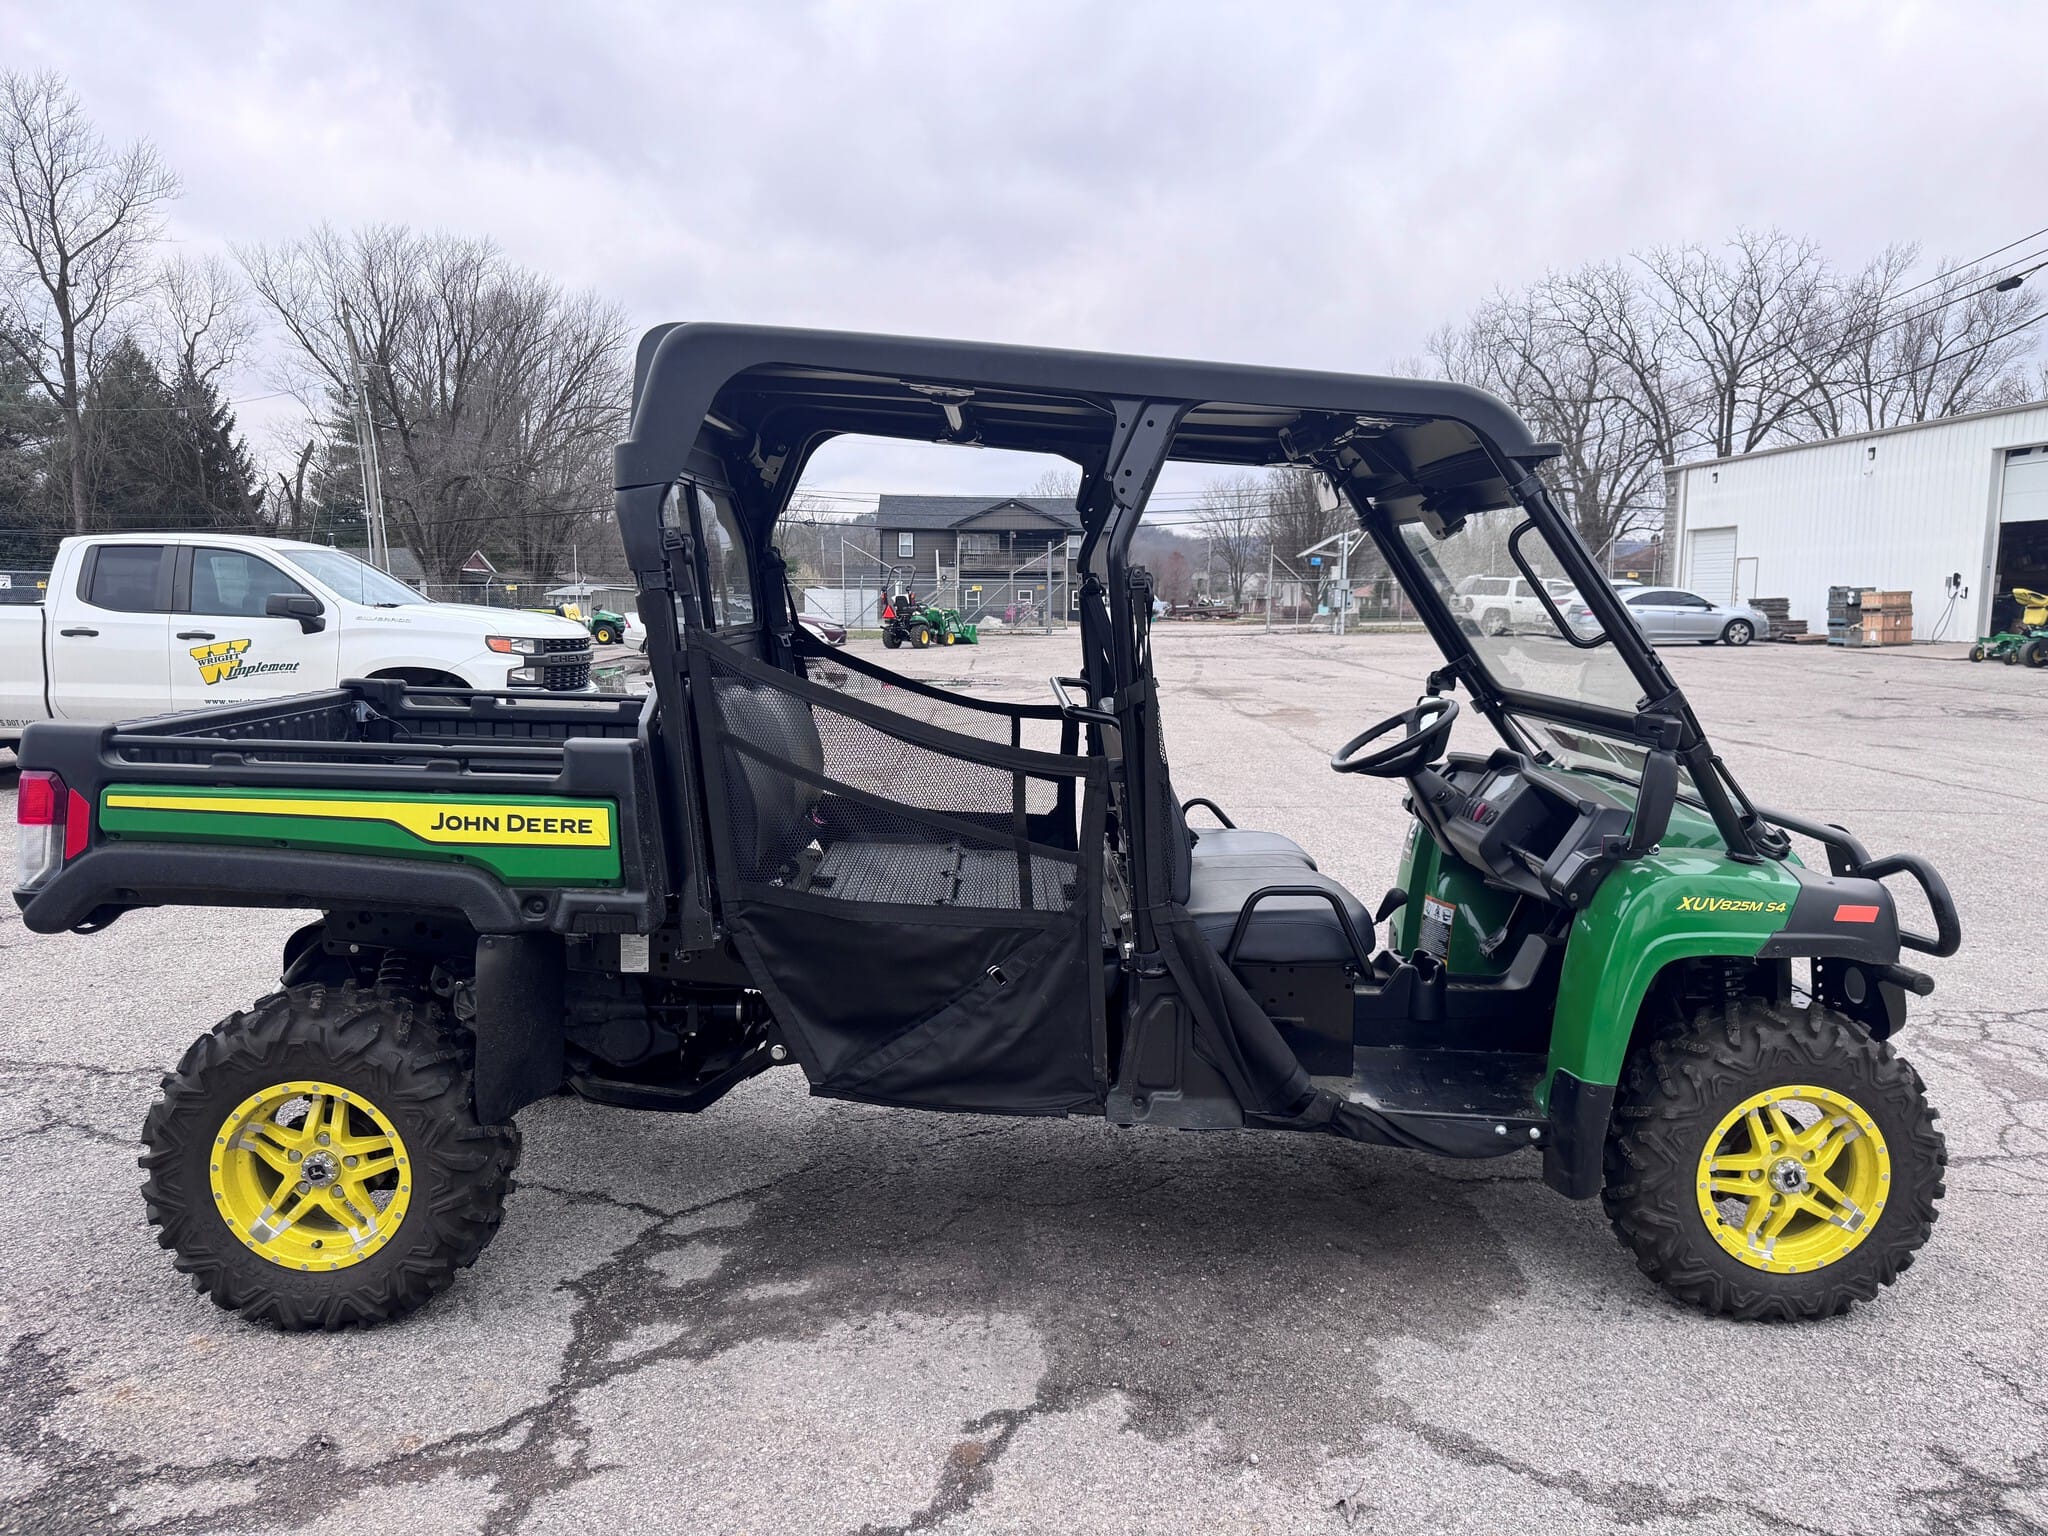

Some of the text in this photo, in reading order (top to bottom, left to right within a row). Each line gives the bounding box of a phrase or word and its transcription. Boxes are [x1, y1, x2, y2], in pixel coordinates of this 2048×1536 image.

[198, 653, 240, 667] WRIGHT
[227, 661, 300, 679] Implement
[431, 812, 593, 834] JOHN DEERE
[1676, 896, 1787, 912] XUV825M S4
